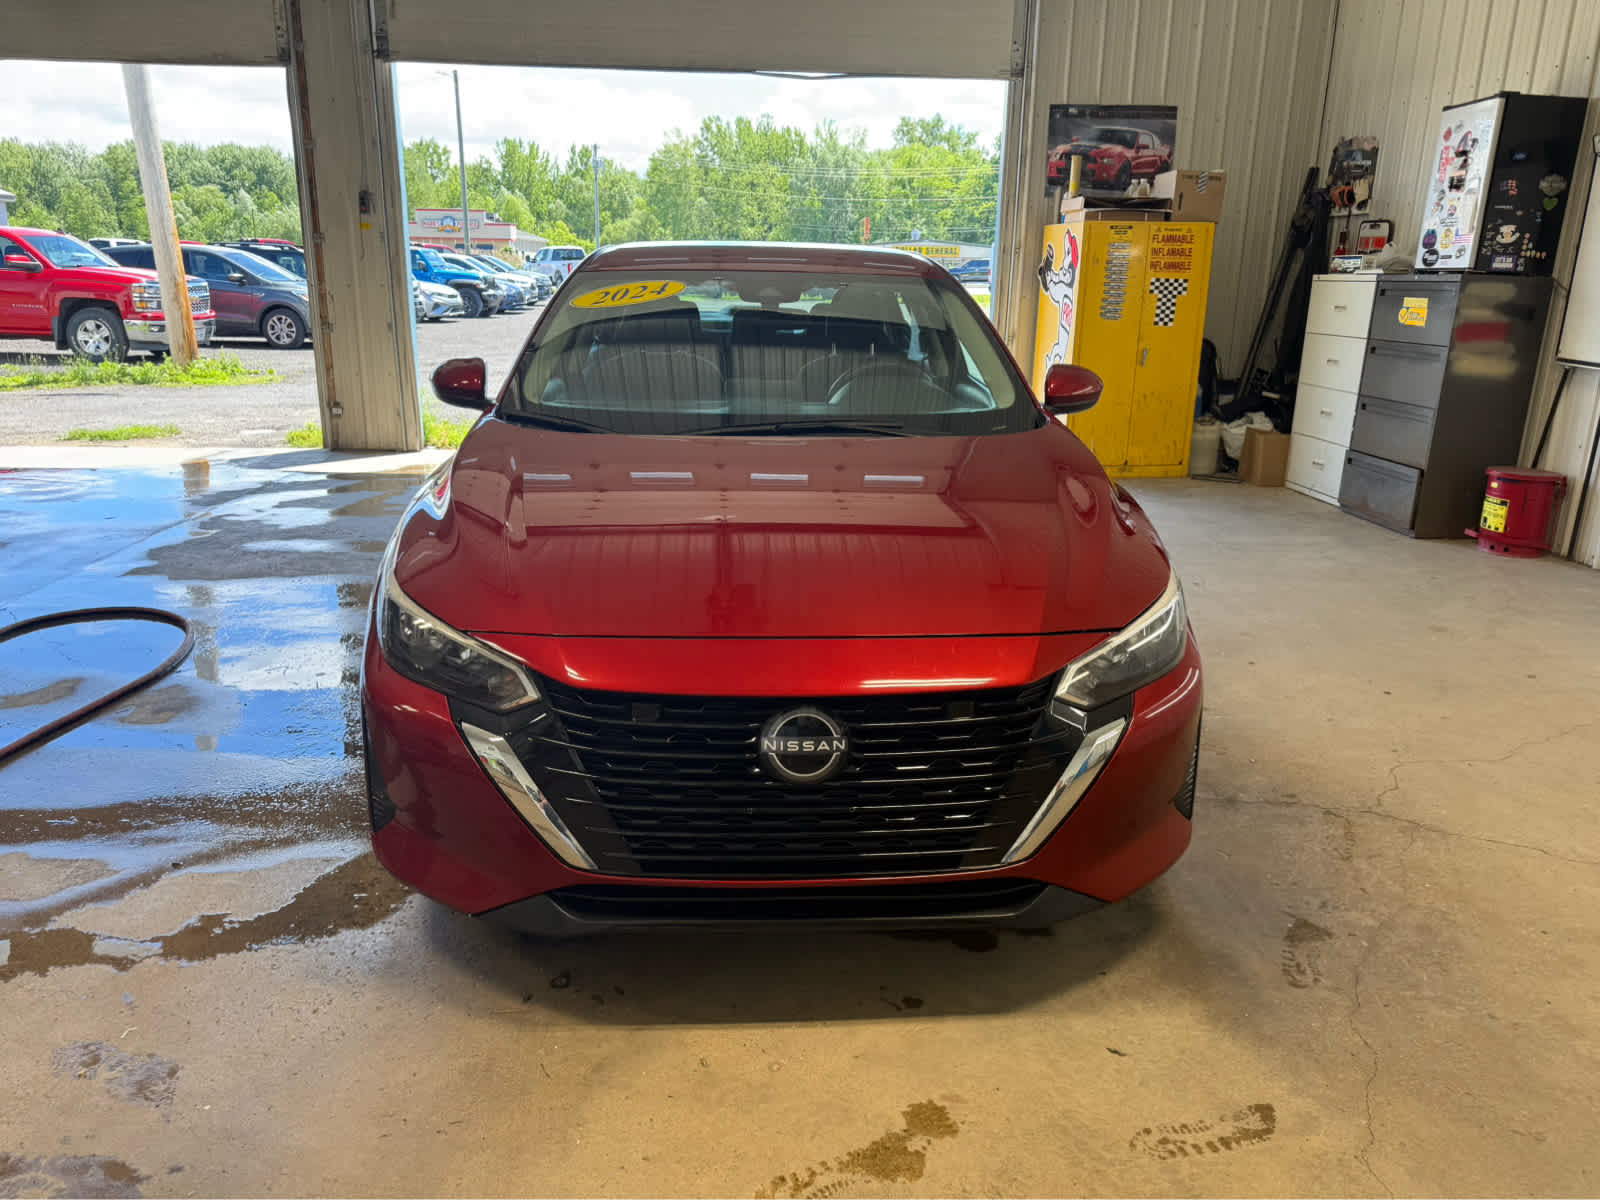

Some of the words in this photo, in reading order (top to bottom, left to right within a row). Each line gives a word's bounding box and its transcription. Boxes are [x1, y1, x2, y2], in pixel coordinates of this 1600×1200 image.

[1152, 234, 1195, 244] FLAMMABLE
[592, 282, 669, 305] 2024
[763, 739, 846, 752] NISSAN
